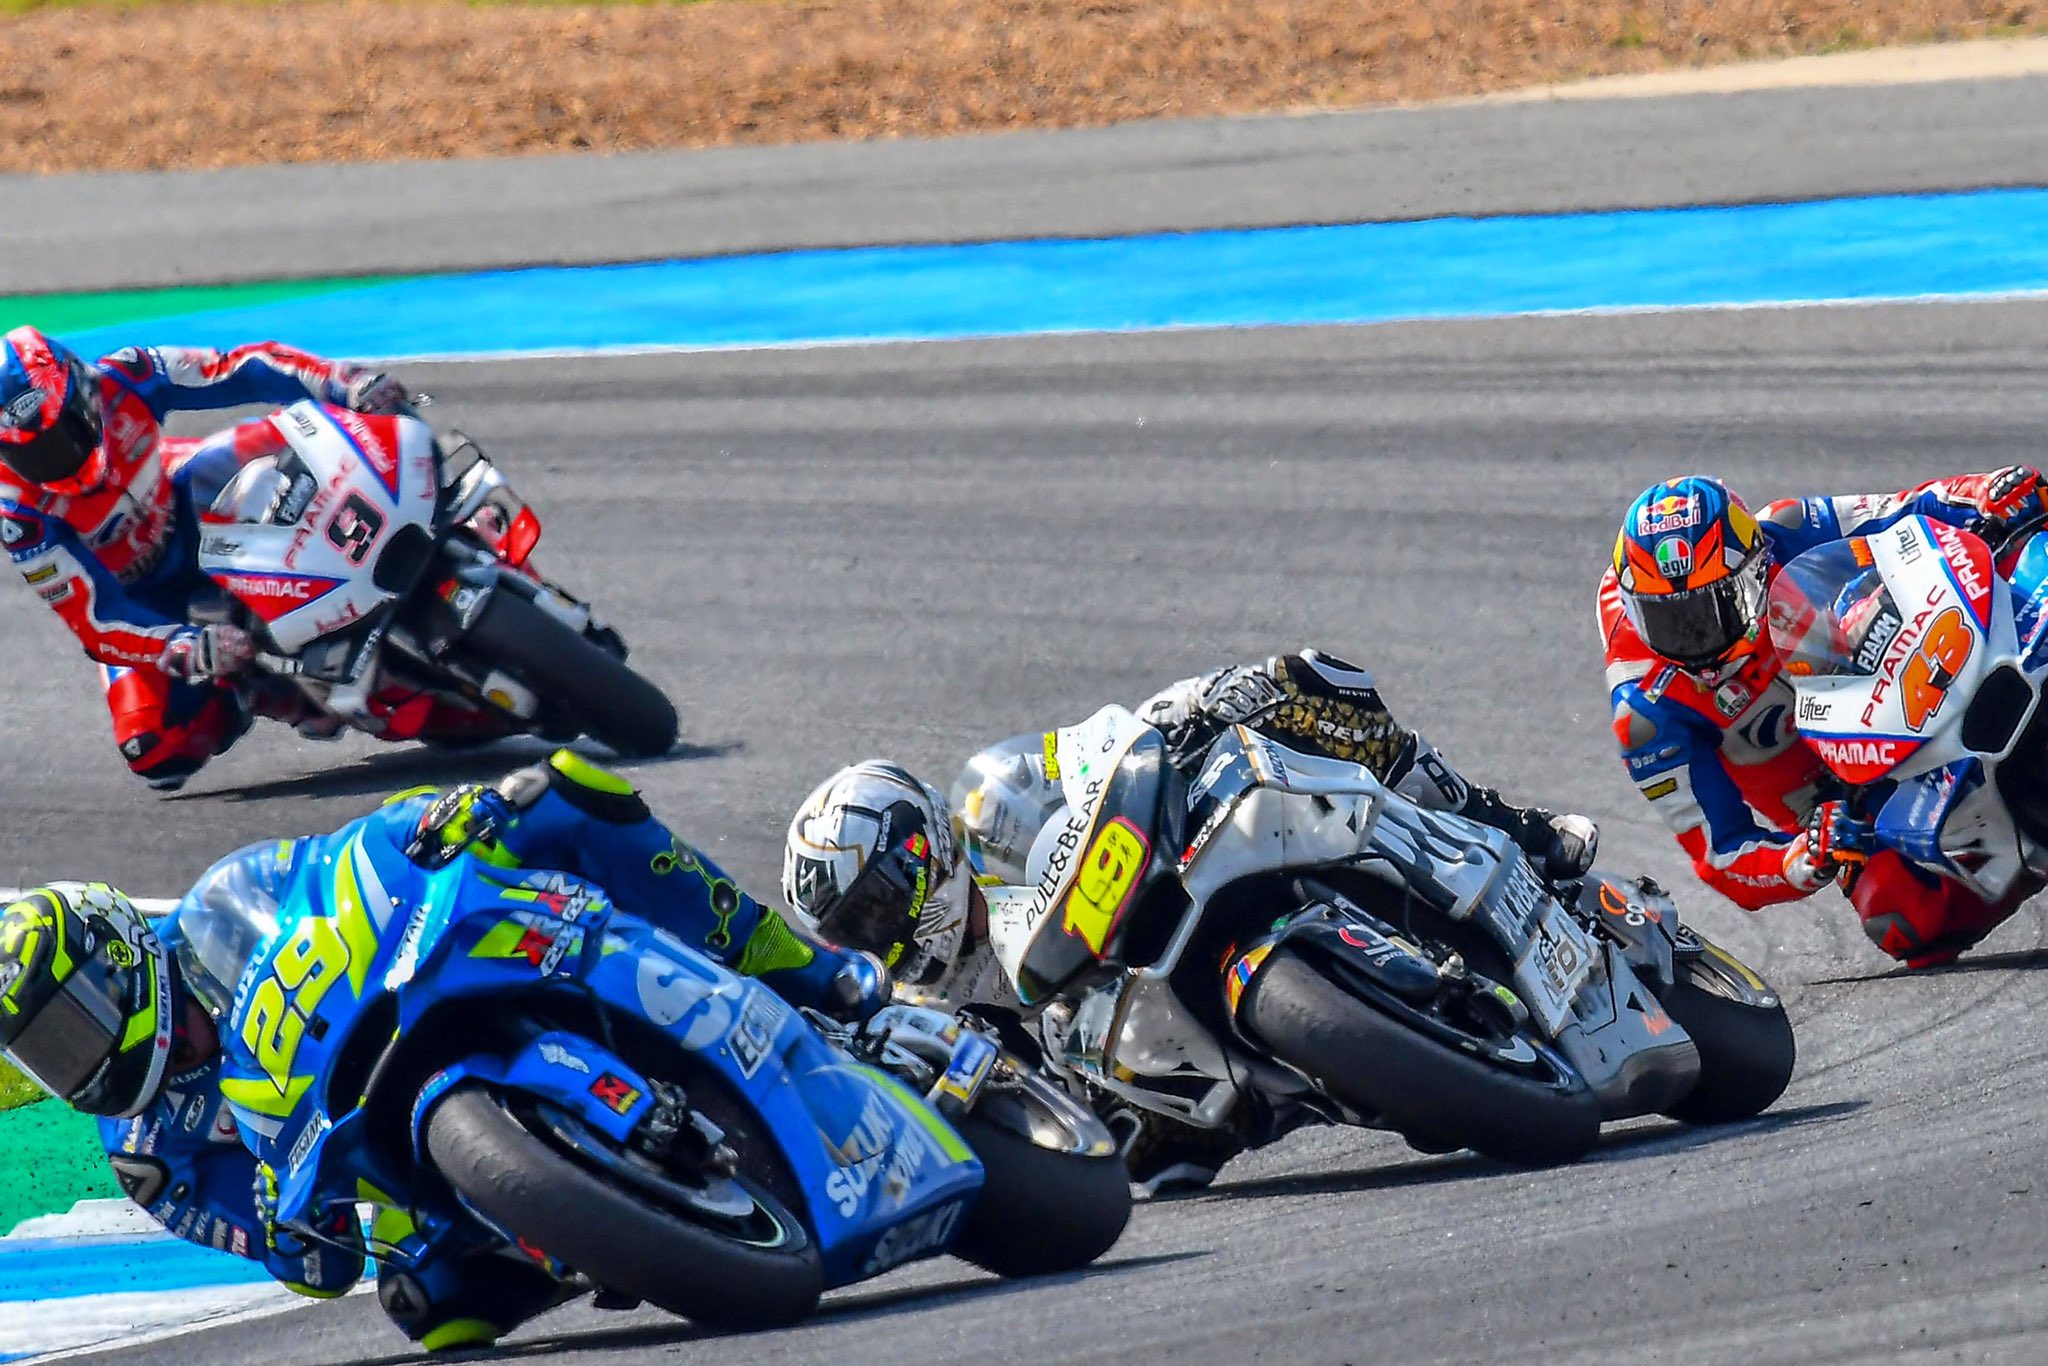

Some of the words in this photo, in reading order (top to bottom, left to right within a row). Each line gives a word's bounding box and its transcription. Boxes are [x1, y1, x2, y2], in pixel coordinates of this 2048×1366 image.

[1662, 559, 1689, 576] agv
[1800, 696, 1832, 721] Lifter
[1860, 584, 1947, 728] PRAMAC
[1899, 605, 1975, 733] 43
[1818, 740, 1896, 766] PRAMAC
[1026, 777, 1103, 931] PULL&BEAR
[1063, 816, 1151, 960] 19
[242, 915, 350, 1099] 29
